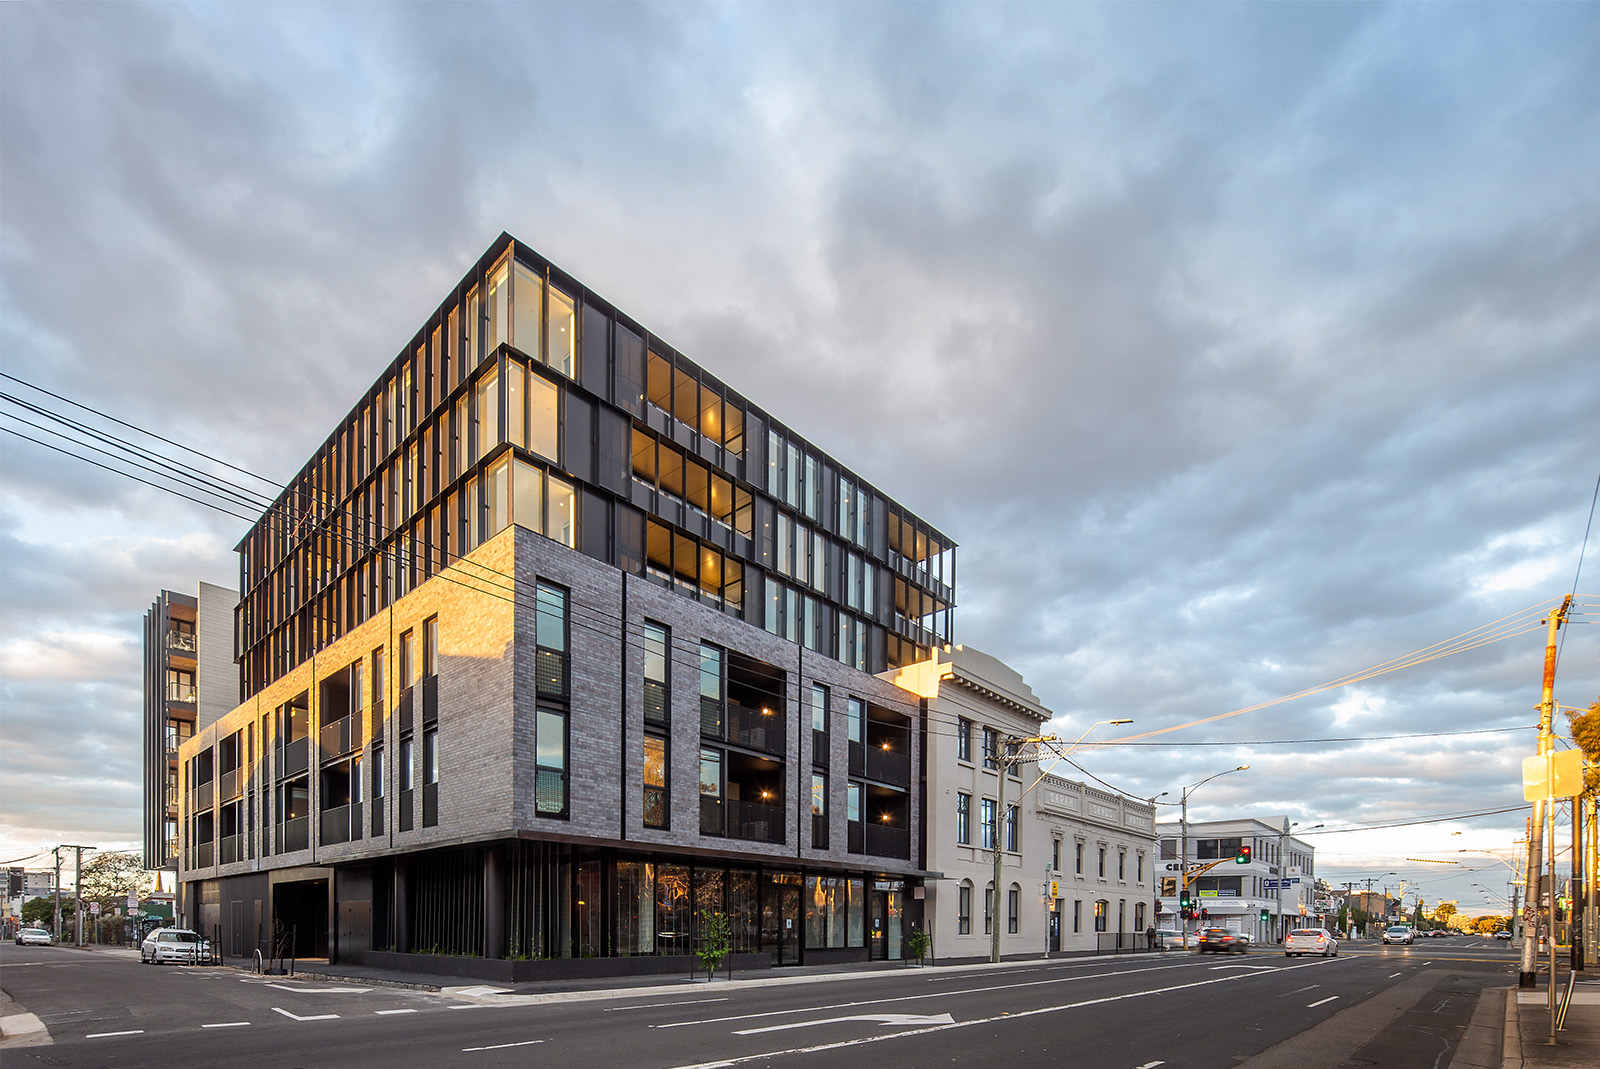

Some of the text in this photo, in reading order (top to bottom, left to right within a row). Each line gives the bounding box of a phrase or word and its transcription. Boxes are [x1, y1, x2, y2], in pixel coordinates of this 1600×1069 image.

[1049, 792, 1146, 828] SARAH SANDS HOTEL
